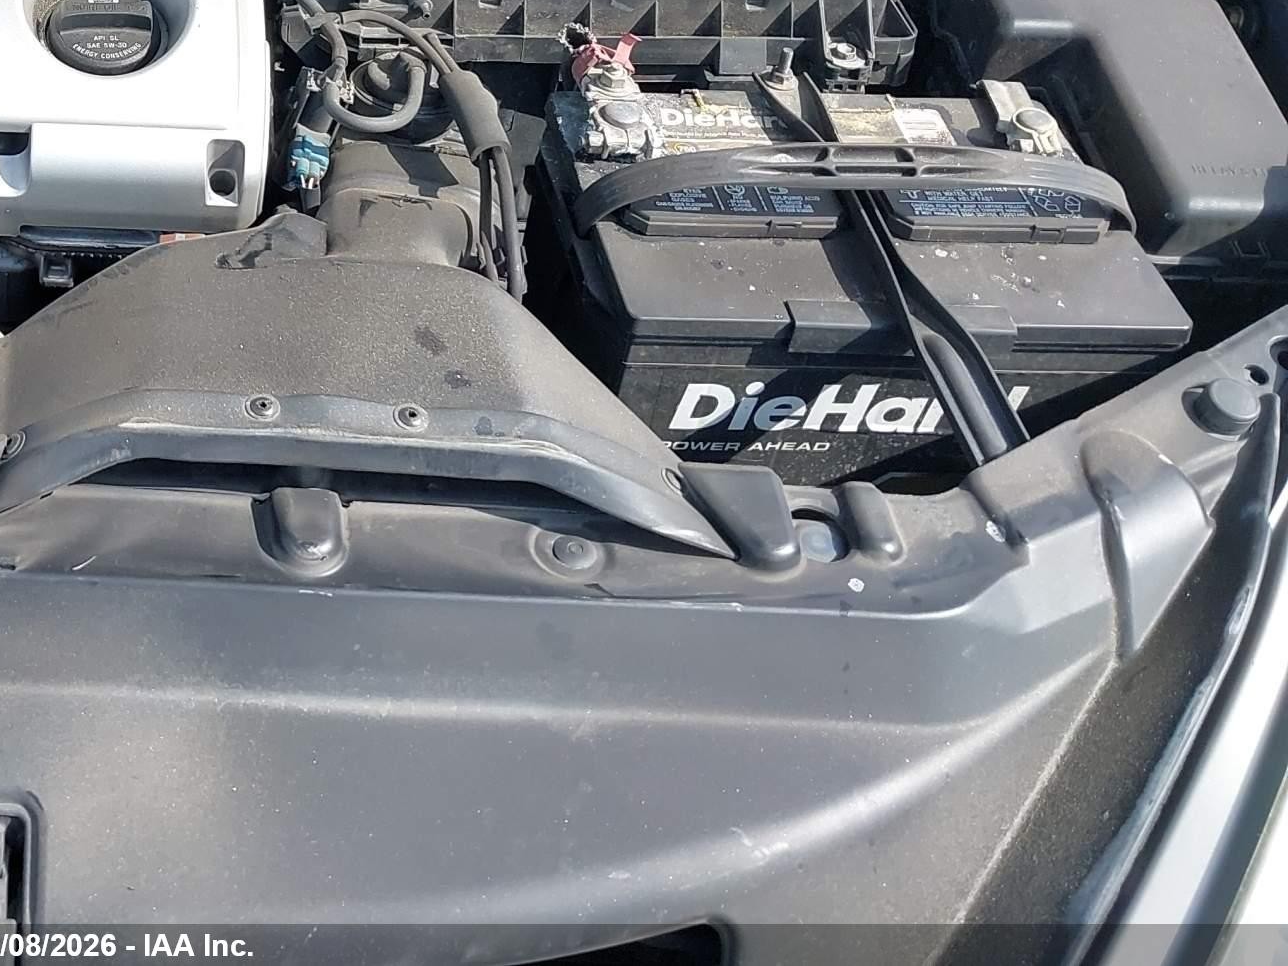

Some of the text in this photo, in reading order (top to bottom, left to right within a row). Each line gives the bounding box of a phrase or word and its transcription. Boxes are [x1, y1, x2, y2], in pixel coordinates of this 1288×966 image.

[72, 42, 142, 59] ENERGY CONSERVING
[662, 108, 788, 129] DieHar
[747, 442, 831, 451] AHEAD
